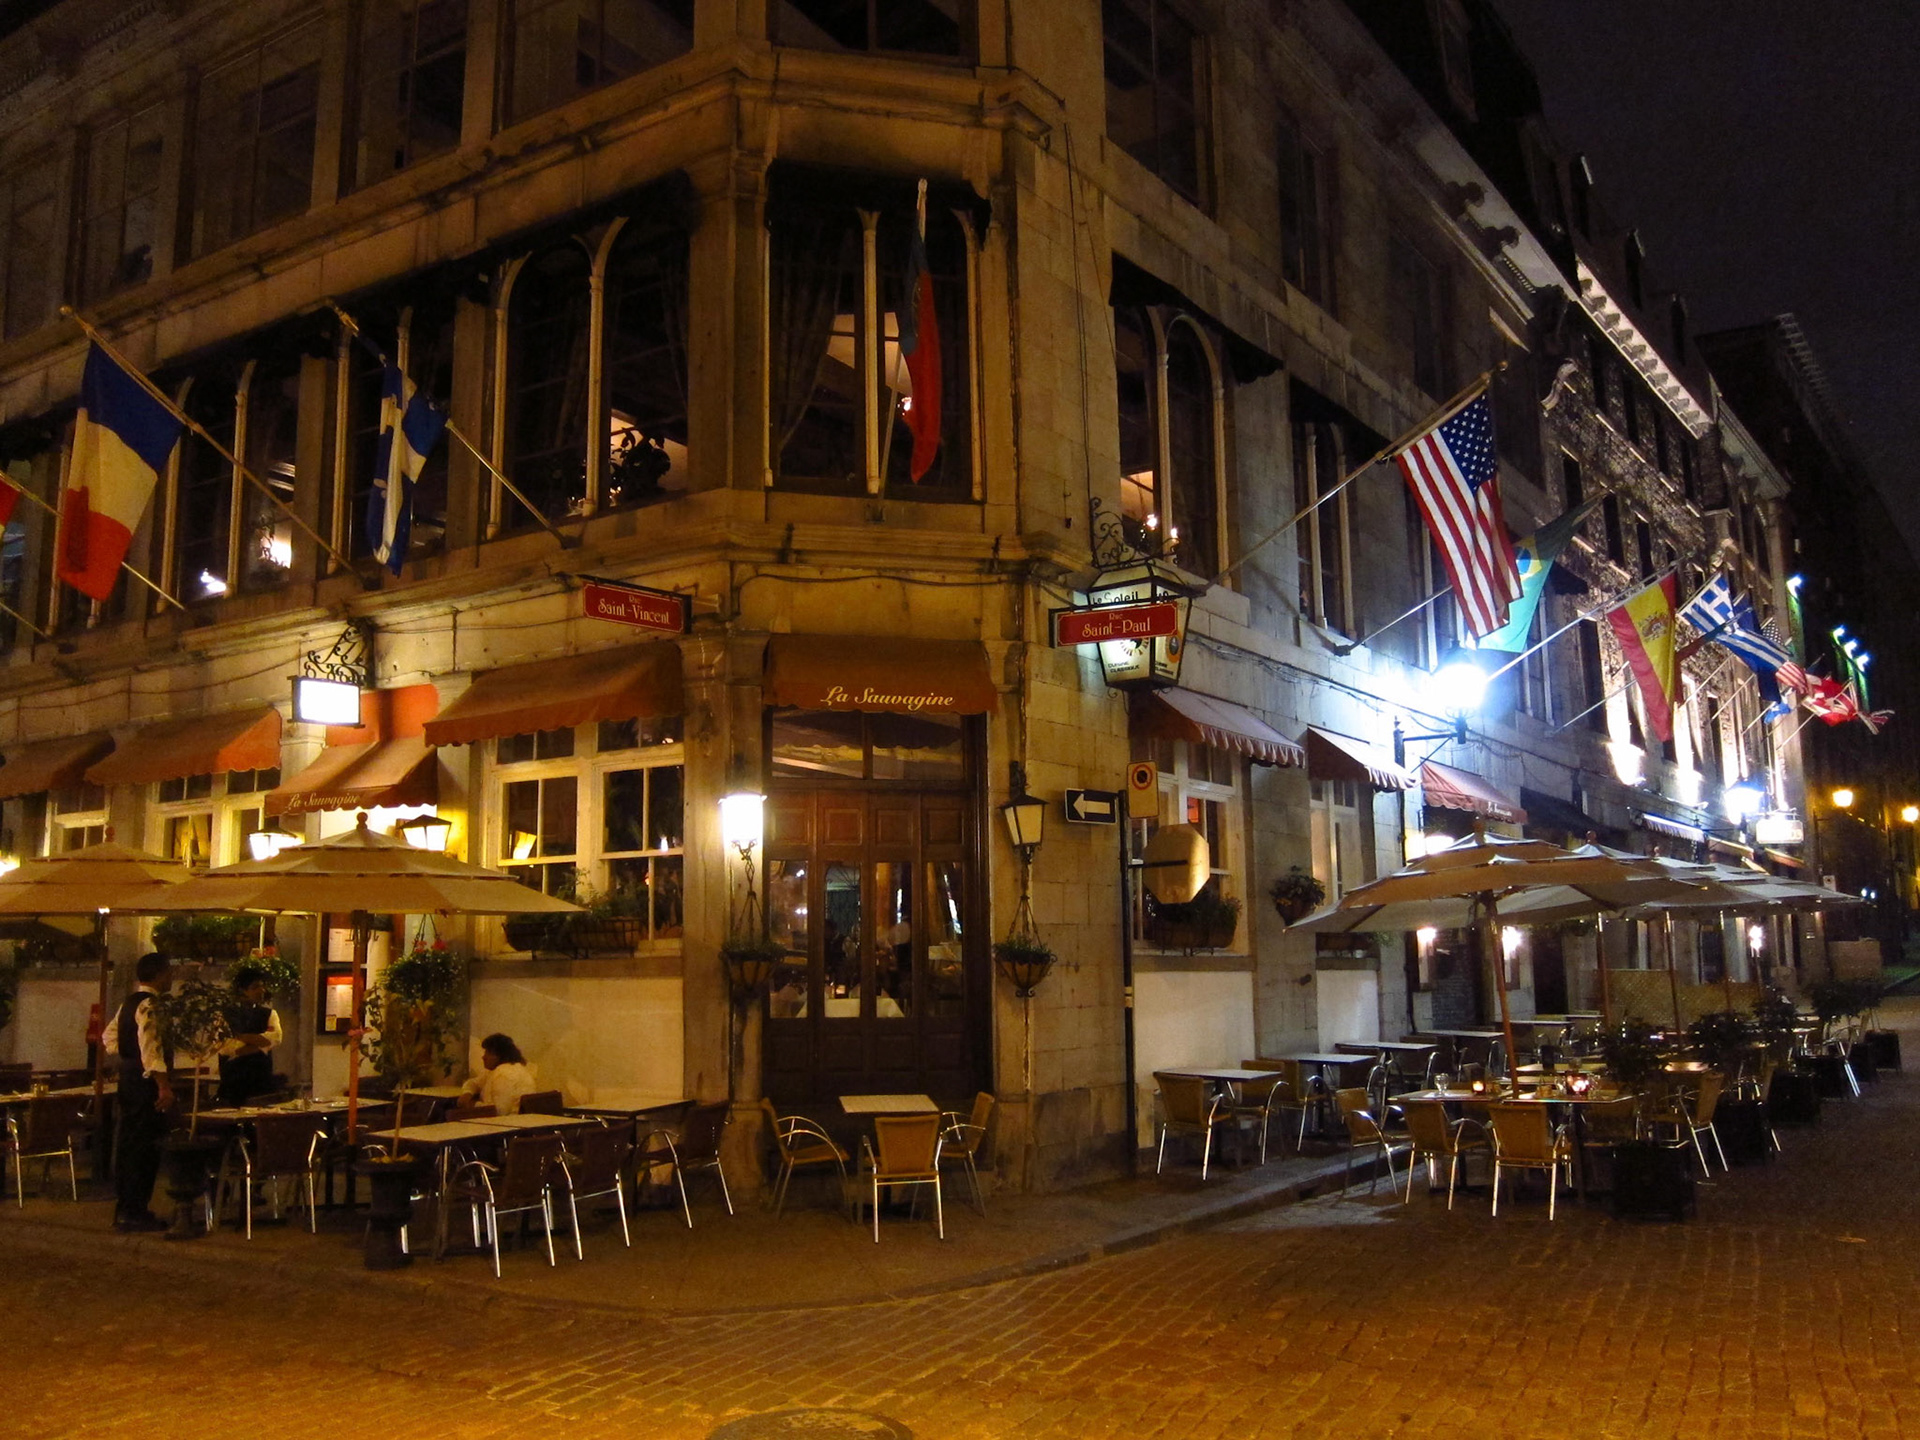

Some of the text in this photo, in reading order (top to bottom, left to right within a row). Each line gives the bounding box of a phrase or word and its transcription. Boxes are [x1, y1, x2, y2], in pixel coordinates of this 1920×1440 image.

[1104, 591, 1139, 603] Soleil
[598, 598, 671, 624] Saint-Vincent
[1082, 617, 1151, 638] Saint-Paul
[820, 685, 955, 711] La Sauvagine
[285, 792, 360, 811] La Sauvagine
